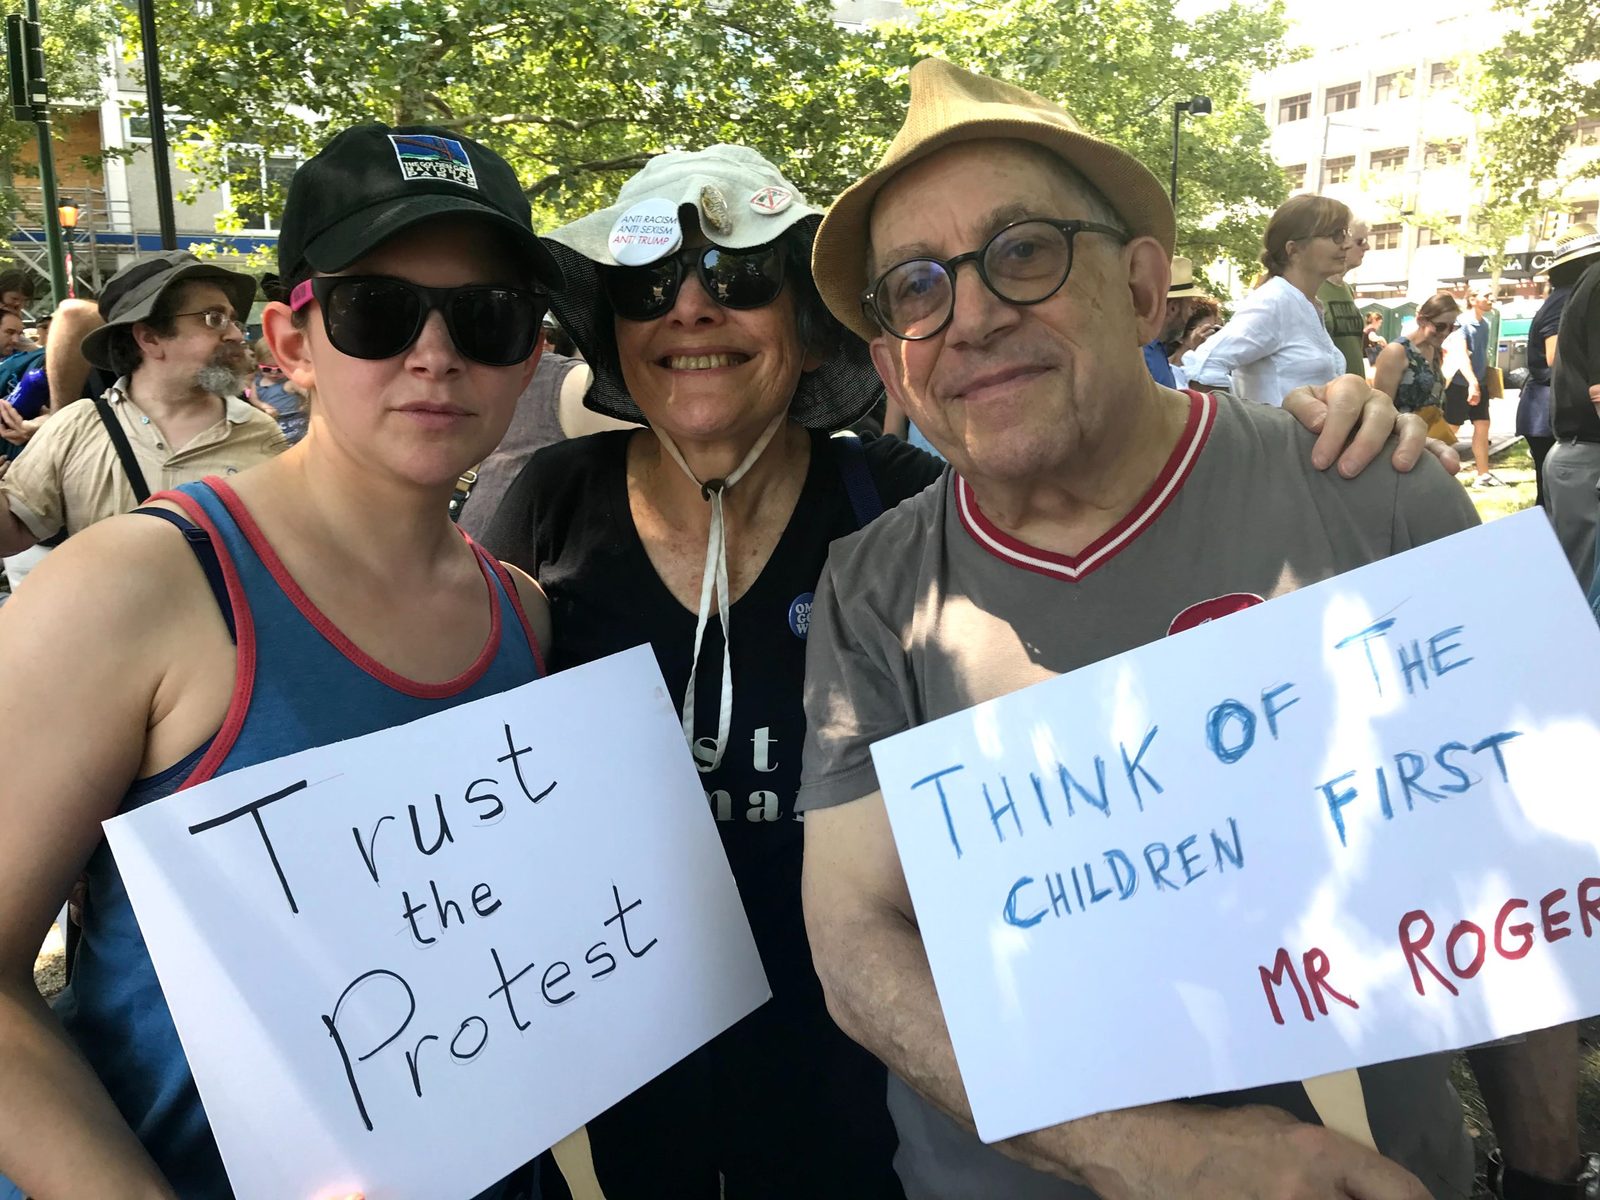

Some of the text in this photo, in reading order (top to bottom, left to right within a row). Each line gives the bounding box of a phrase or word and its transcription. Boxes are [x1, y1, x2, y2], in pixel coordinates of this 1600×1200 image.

[613, 235, 670, 245] ANTI TRUMP
[617, 225, 673, 235] ANTI SEXISM
[621, 215, 677, 224] ANTI RACISM
[1531, 254, 1556, 269] CE
[911, 613, 1474, 859] THINK OF THE
[188, 723, 558, 915] Trust
[1003, 730, 1524, 928] CHILDREN FIRST
[402, 880, 503, 945] the
[321, 885, 659, 1132] Protest
[1259, 946, 1359, 1025] MR
